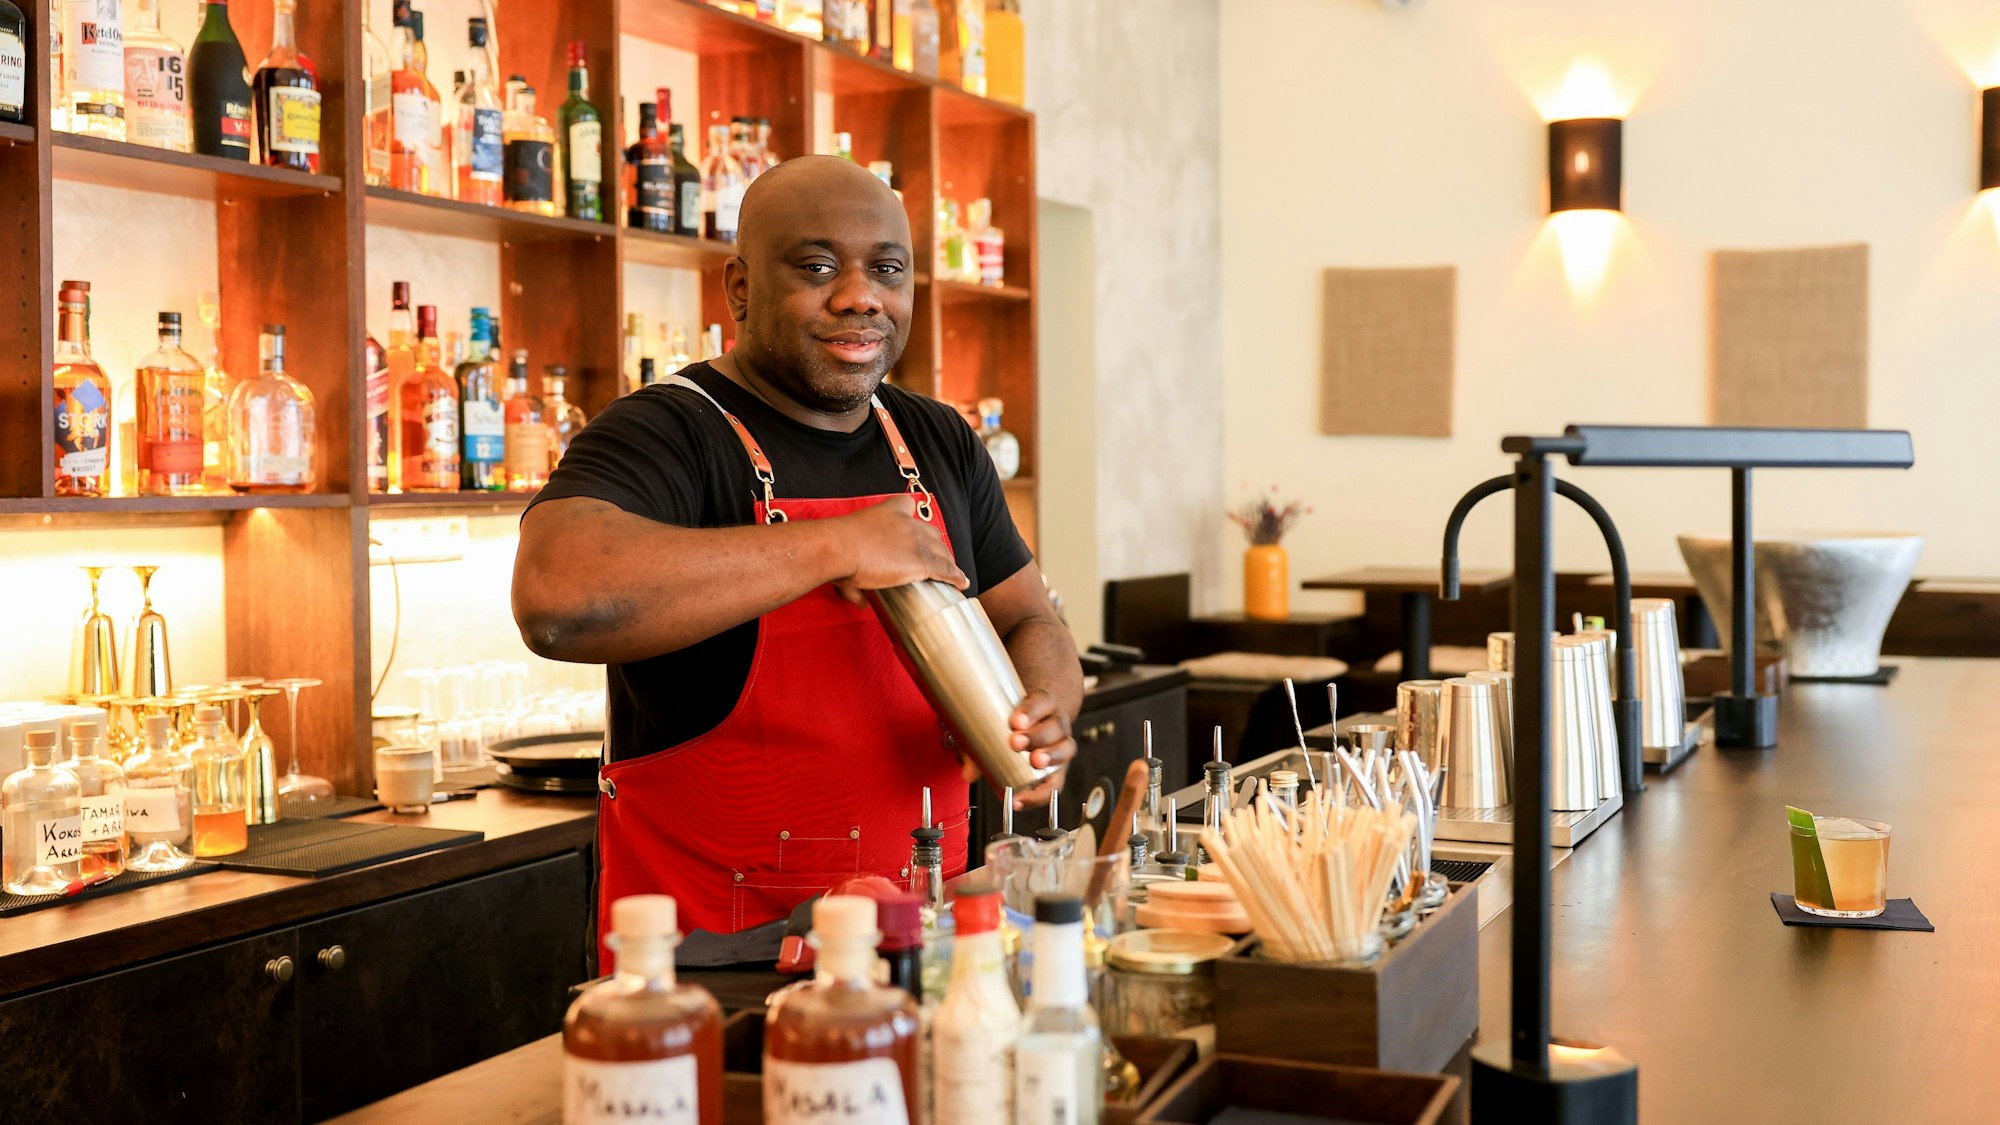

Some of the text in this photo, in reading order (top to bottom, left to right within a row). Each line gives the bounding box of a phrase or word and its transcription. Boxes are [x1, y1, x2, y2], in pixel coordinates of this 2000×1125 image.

[84, 25, 112, 41] Ketel
[158, 56, 182, 74] 16
[167, 75, 184, 101] 15
[58, 412, 107, 430] STORK
[476, 442, 490, 458] 12
[46, 845, 81, 860] ARRA
